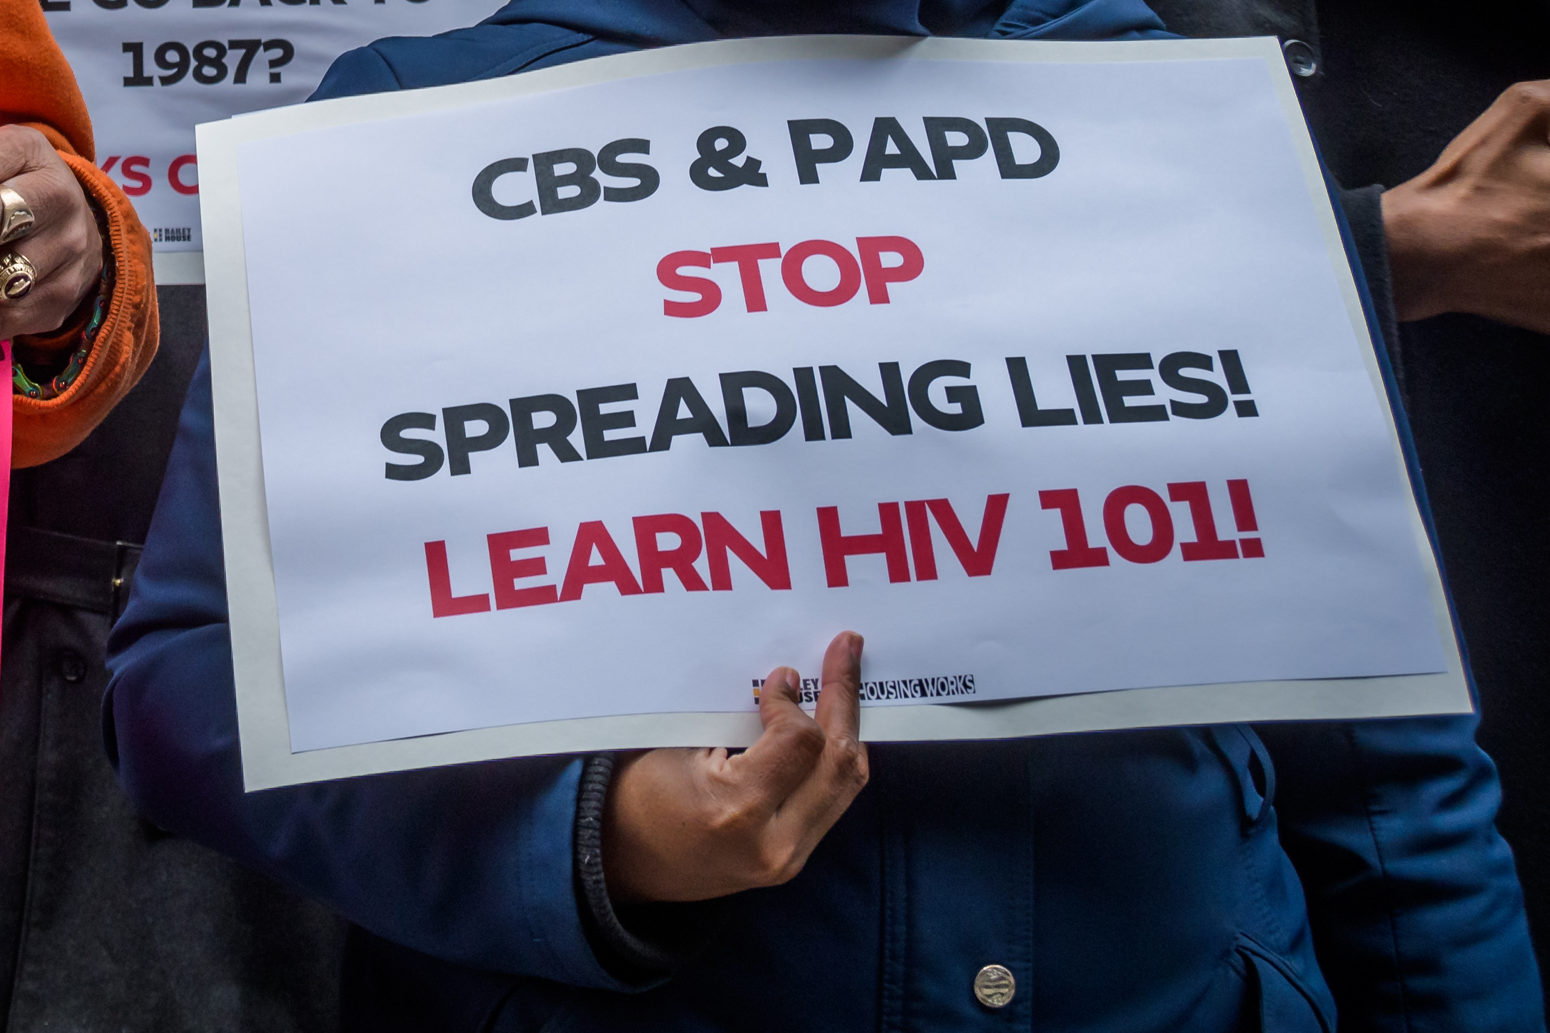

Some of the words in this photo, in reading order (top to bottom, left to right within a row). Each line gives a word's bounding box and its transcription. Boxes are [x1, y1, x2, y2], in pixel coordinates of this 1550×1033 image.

[122, 38, 295, 88] 1987?
[471, 138, 661, 222] CBS
[689, 125, 769, 193] &
[786, 116, 1061, 186] PAPD
[655, 234, 926, 319] STOP
[380, 359, 985, 482] SPREADING
[1015, 349, 1260, 429] LIES!
[423, 508, 792, 620] LEARN
[816, 492, 1012, 590] HIV
[1037, 478, 1266, 572] 101!
[923, 674, 976, 697] WORKS
